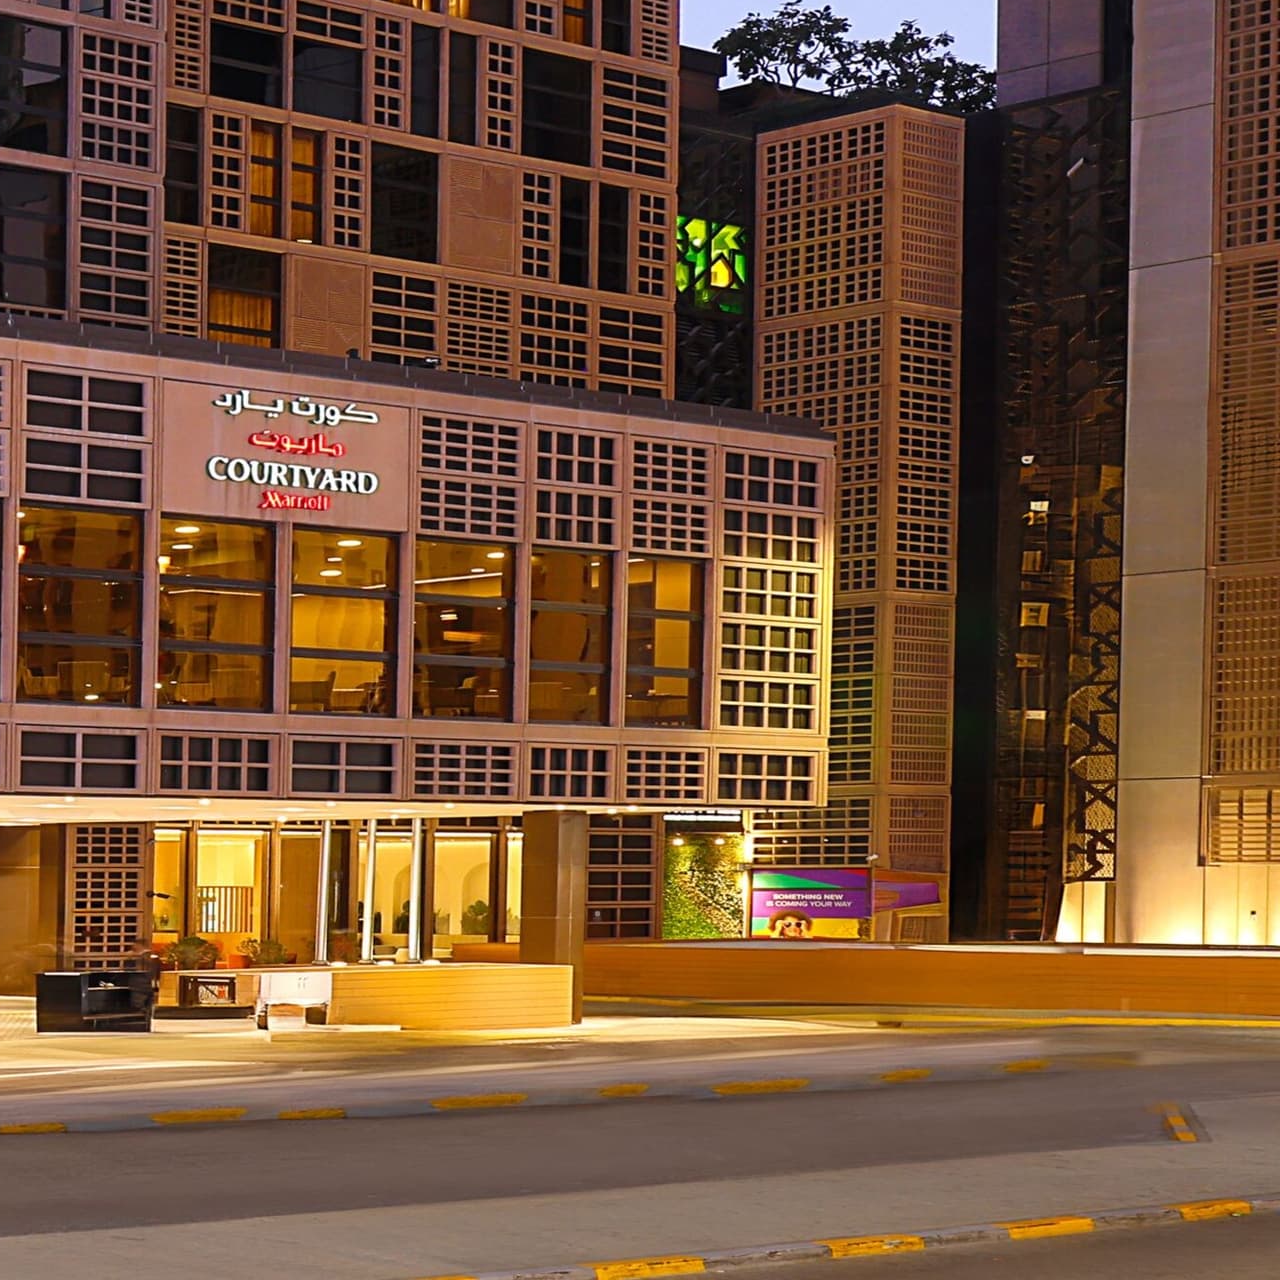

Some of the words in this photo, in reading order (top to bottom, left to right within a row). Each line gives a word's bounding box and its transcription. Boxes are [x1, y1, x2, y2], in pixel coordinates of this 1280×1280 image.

[213, 389, 285, 419] يارد
[290, 395, 379, 427] كورت
[250, 429, 346, 457] ماريوت
[207, 455, 379, 495] COURTYARD
[259, 490, 330, 511] Marriott
